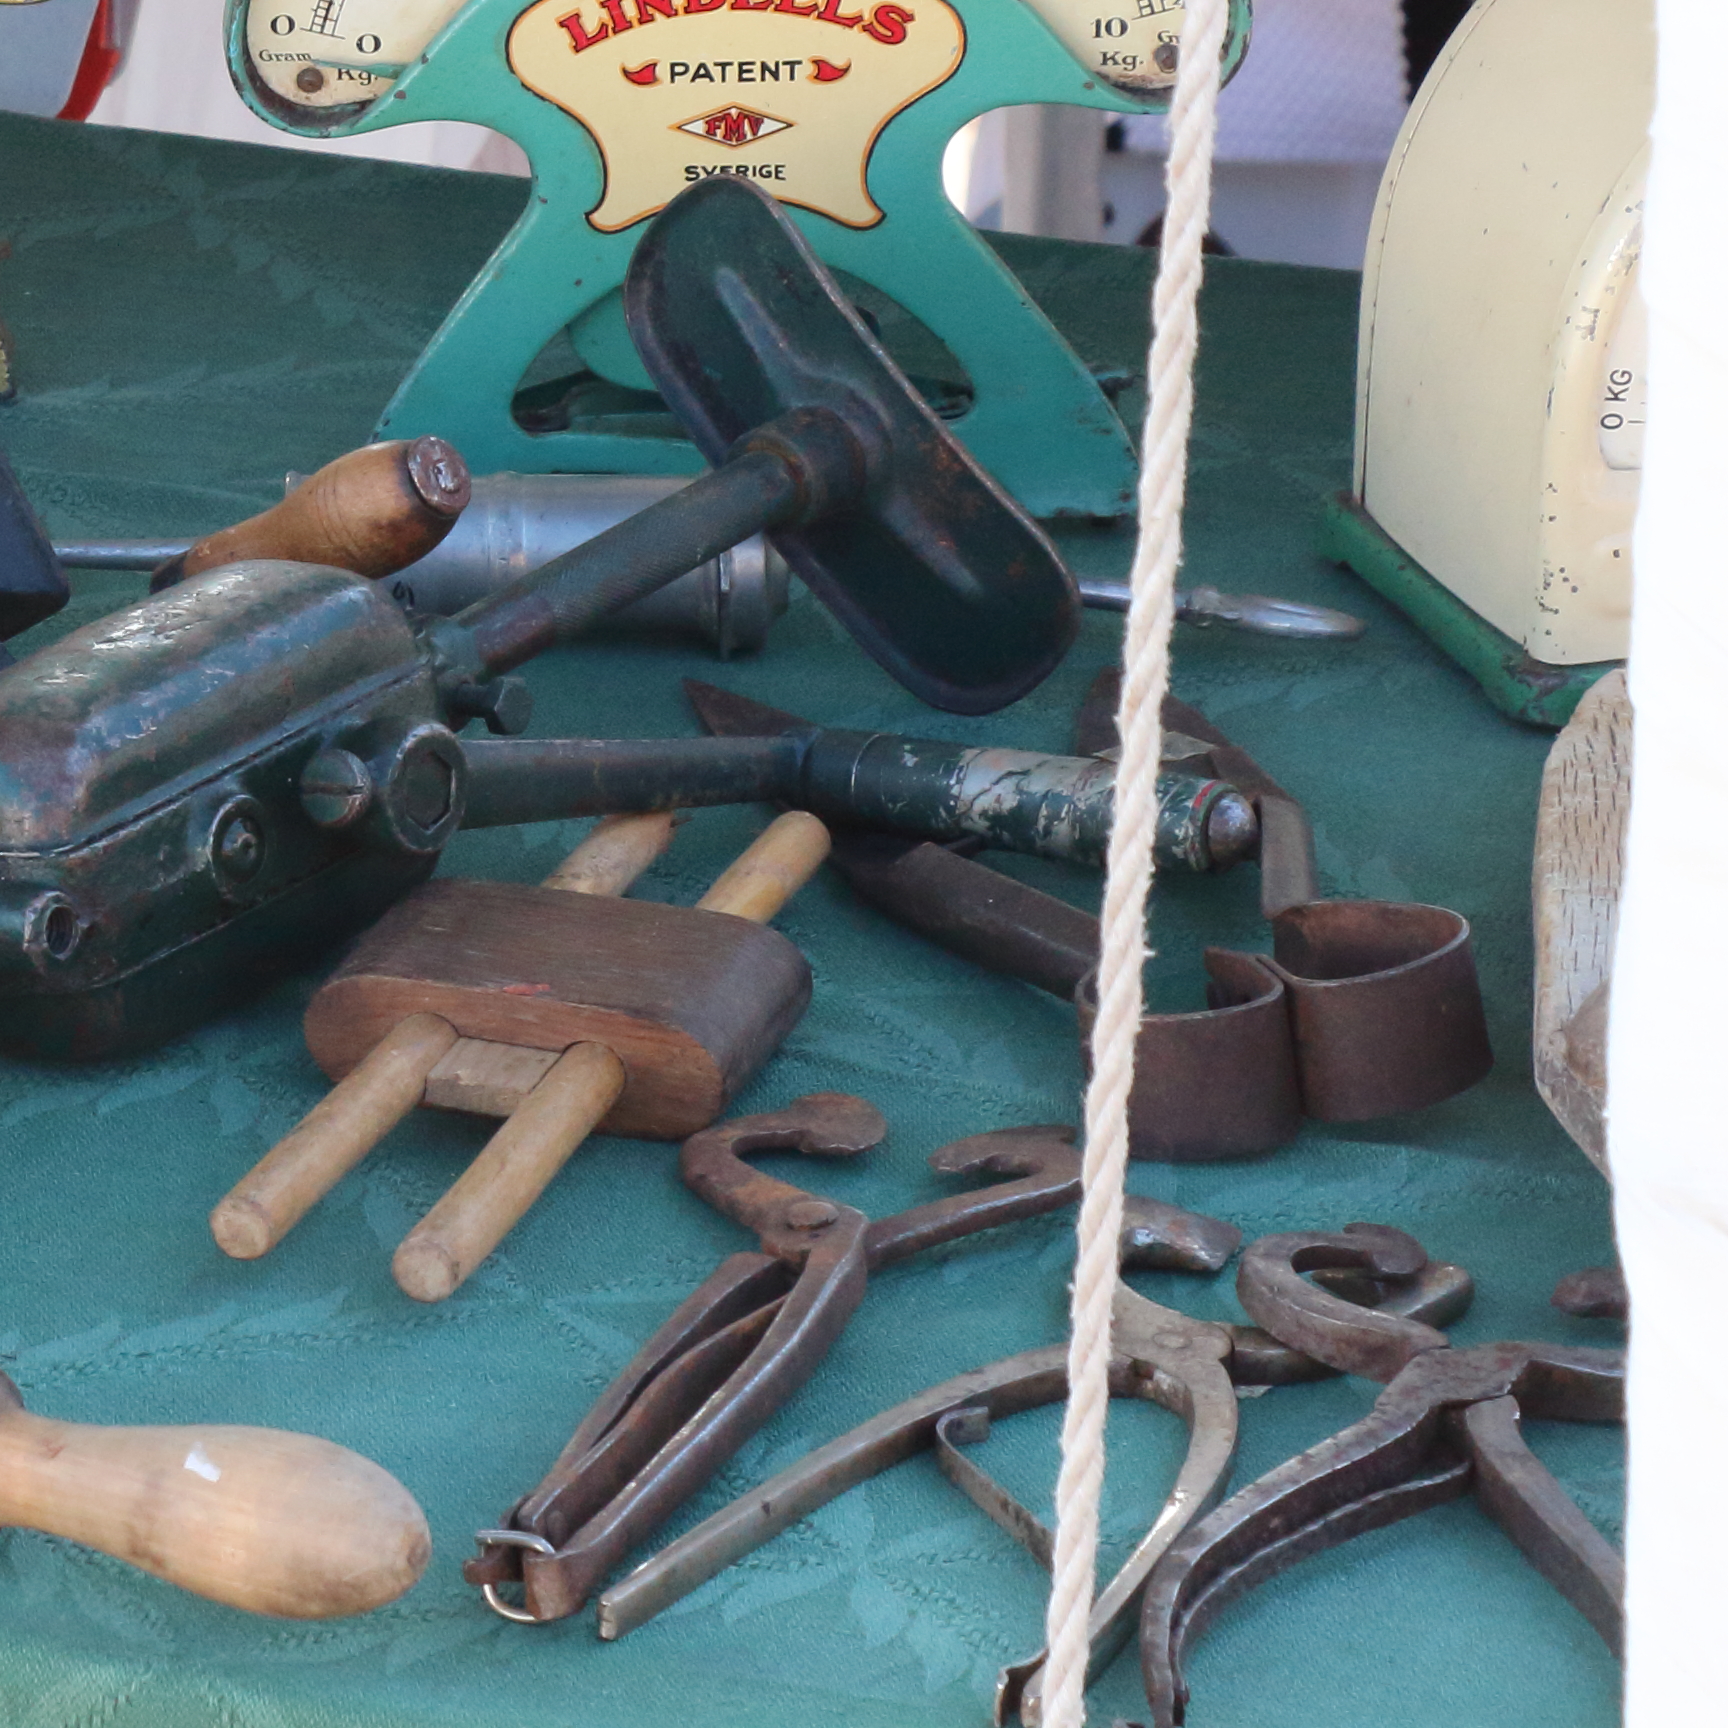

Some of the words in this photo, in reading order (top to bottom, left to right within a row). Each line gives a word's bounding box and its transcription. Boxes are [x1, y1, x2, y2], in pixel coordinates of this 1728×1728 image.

[270, 14, 295, 35] 0
[1091, 17, 1129, 39] 10
[356, 33, 382, 54] 0
[669, 59, 804, 84] PATENT
[705, 113, 765, 142] FMV
[1604, 369, 1633, 402] KG
[1600, 413, 1624, 430] 0
